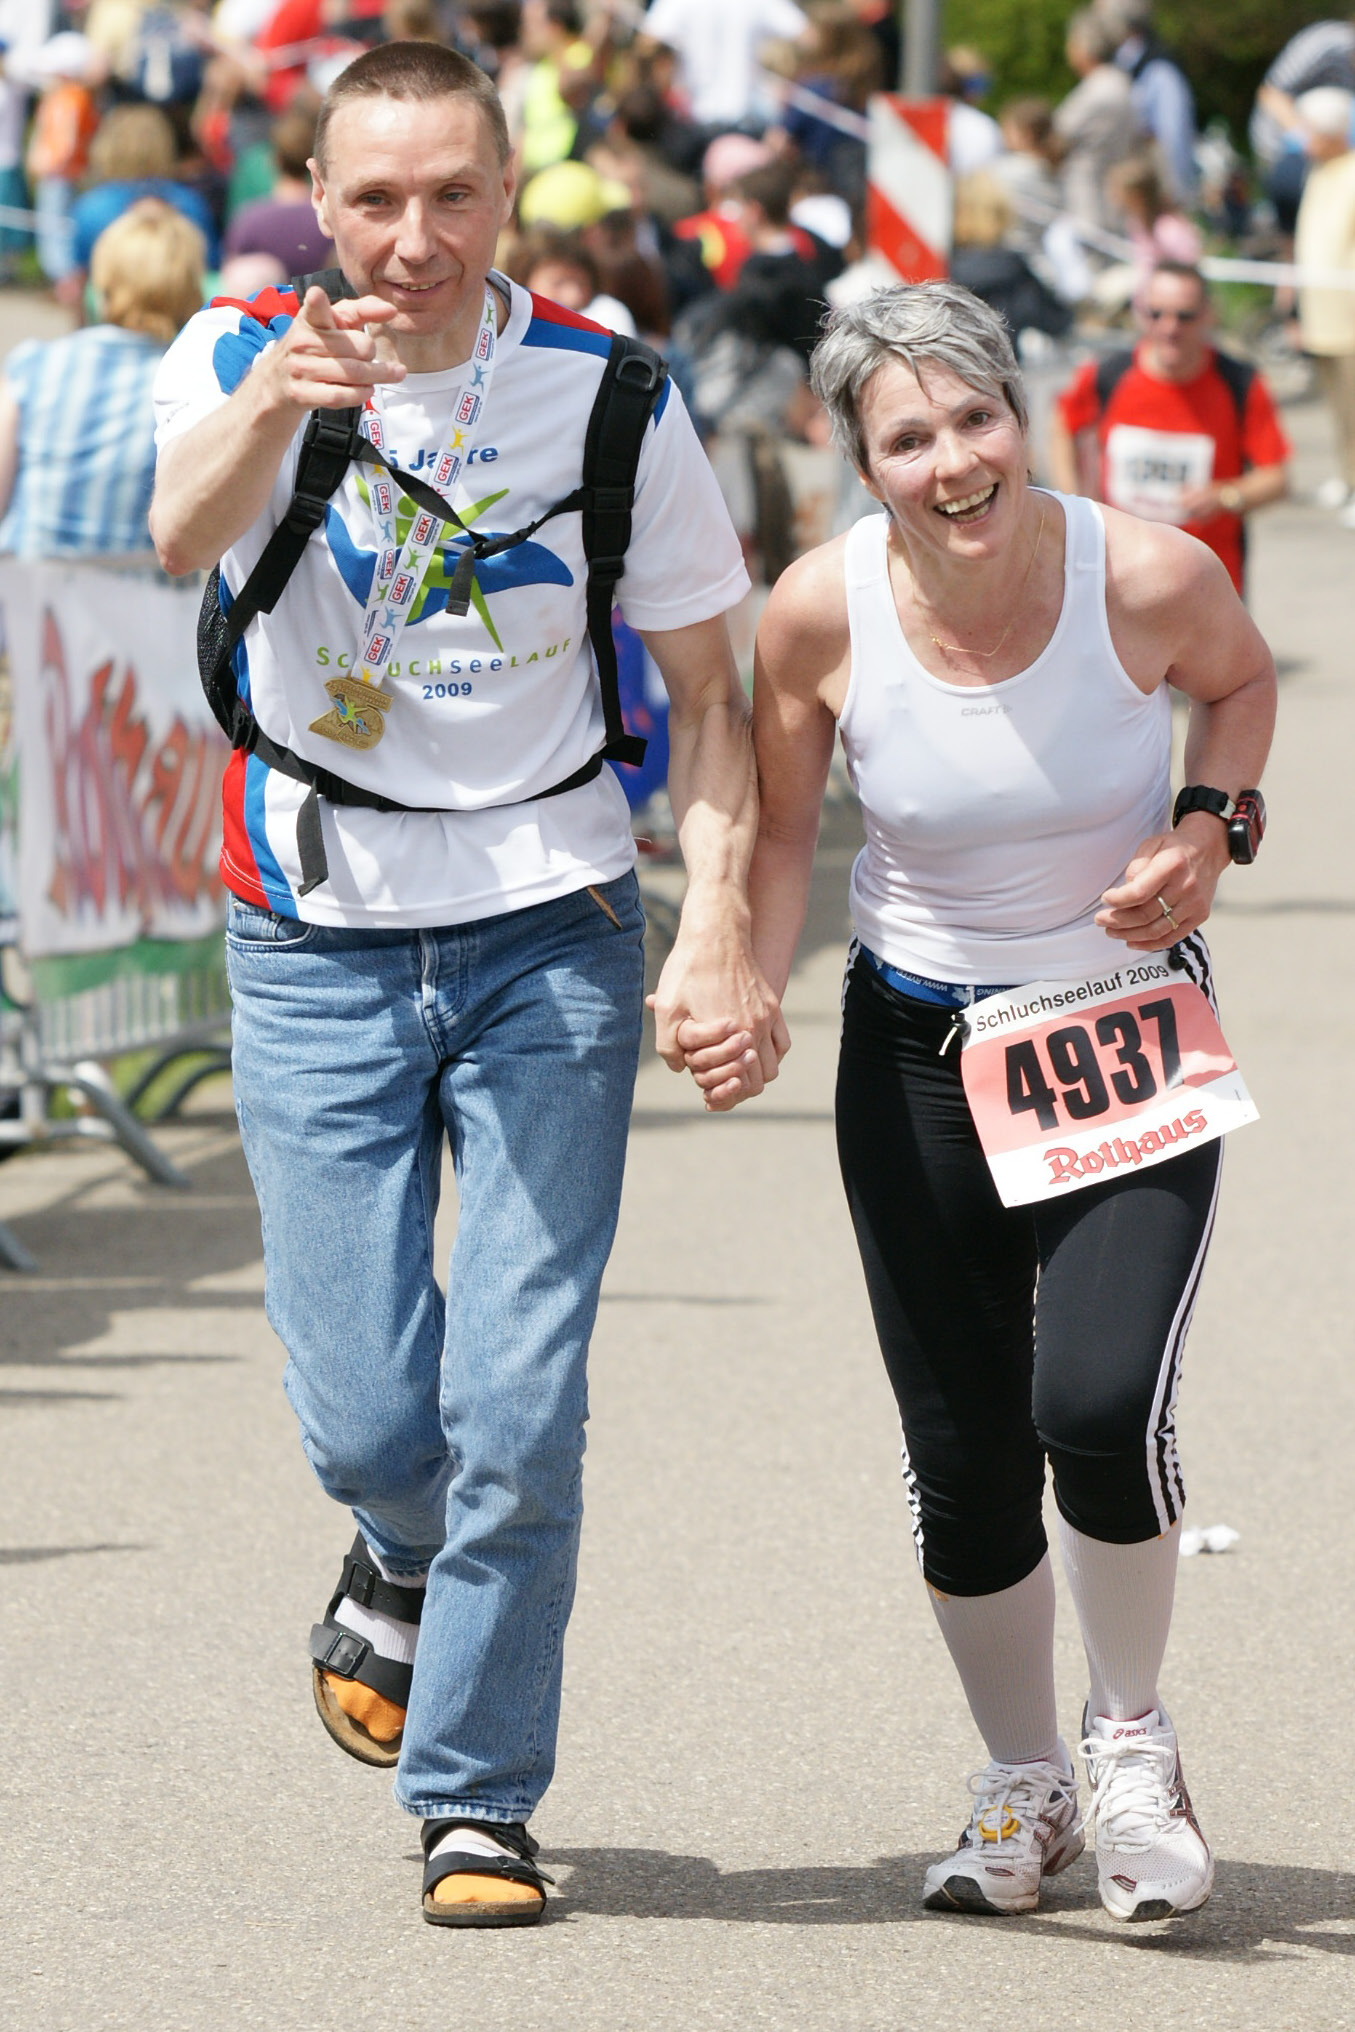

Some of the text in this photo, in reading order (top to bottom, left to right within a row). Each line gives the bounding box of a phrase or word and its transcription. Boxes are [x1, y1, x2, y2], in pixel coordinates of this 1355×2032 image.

[478, 332, 489, 357] GEK
[459, 395, 474, 421] GEK
[370, 422, 382, 447] GEK
[409, 447, 498, 471] Jare
[437, 456, 453, 482] GEK
[379, 486, 390, 511] GEK
[415, 517, 431, 542] GEK
[385, 552, 393, 576] GEK
[392, 576, 408, 600] GEK
[316, 638, 571, 677] SCUCHseeLAUF
[367, 637, 384, 661] GEK
[422, 682, 473, 700] 2009
[961, 705, 1001, 716] CRAFT
[976, 964, 1170, 1032] Schluchseelauf 2009
[1004, 997, 1185, 1132] 4937
[1043, 1109, 1208, 1185] Rothaus
[1125, 1726, 1147, 1738] asics
